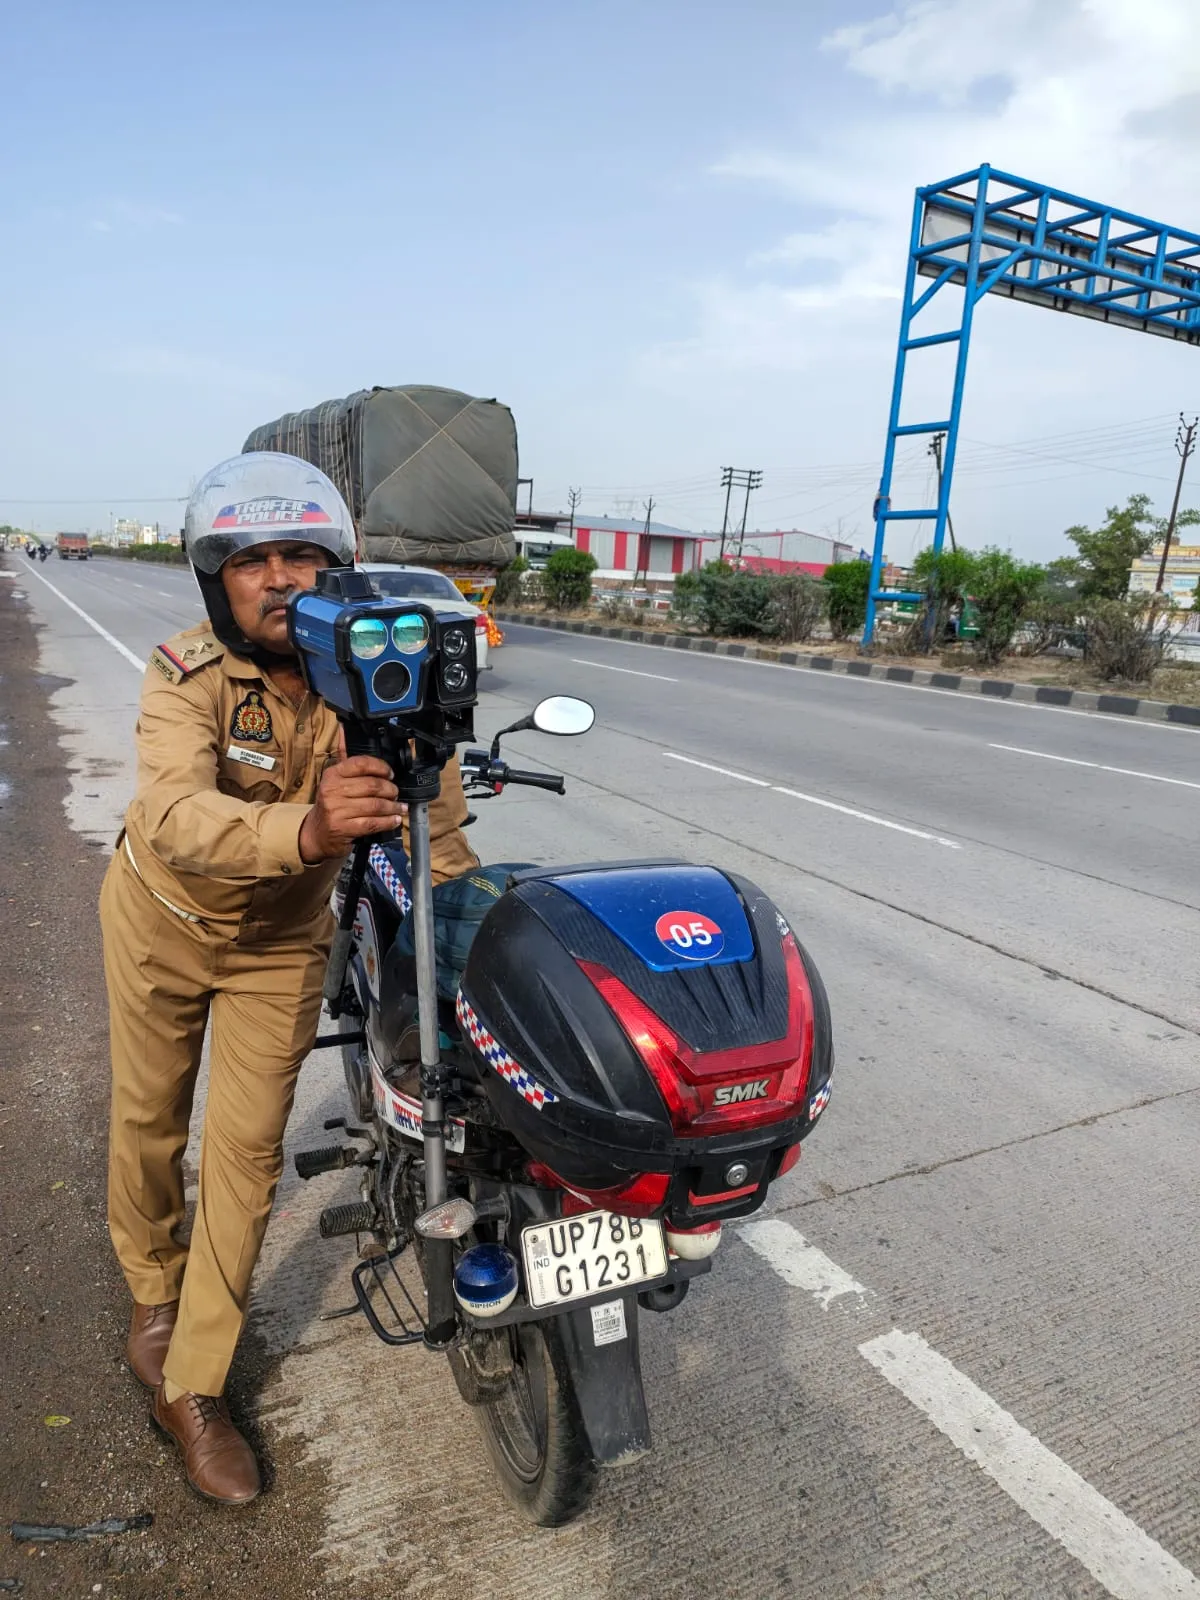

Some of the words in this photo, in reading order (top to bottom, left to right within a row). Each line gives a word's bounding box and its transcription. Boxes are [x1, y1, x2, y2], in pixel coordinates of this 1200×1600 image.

[235, 500, 309, 515] TRAFFIC
[236, 511, 304, 525] POLICE
[669, 922, 712, 948] 05
[712, 1078, 771, 1106] SMK
[549, 1213, 643, 1258] UP78B
[533, 1257, 550, 1270] IND
[556, 1244, 648, 1296] G1231
[469, 1300, 501, 1309] SIPHON
